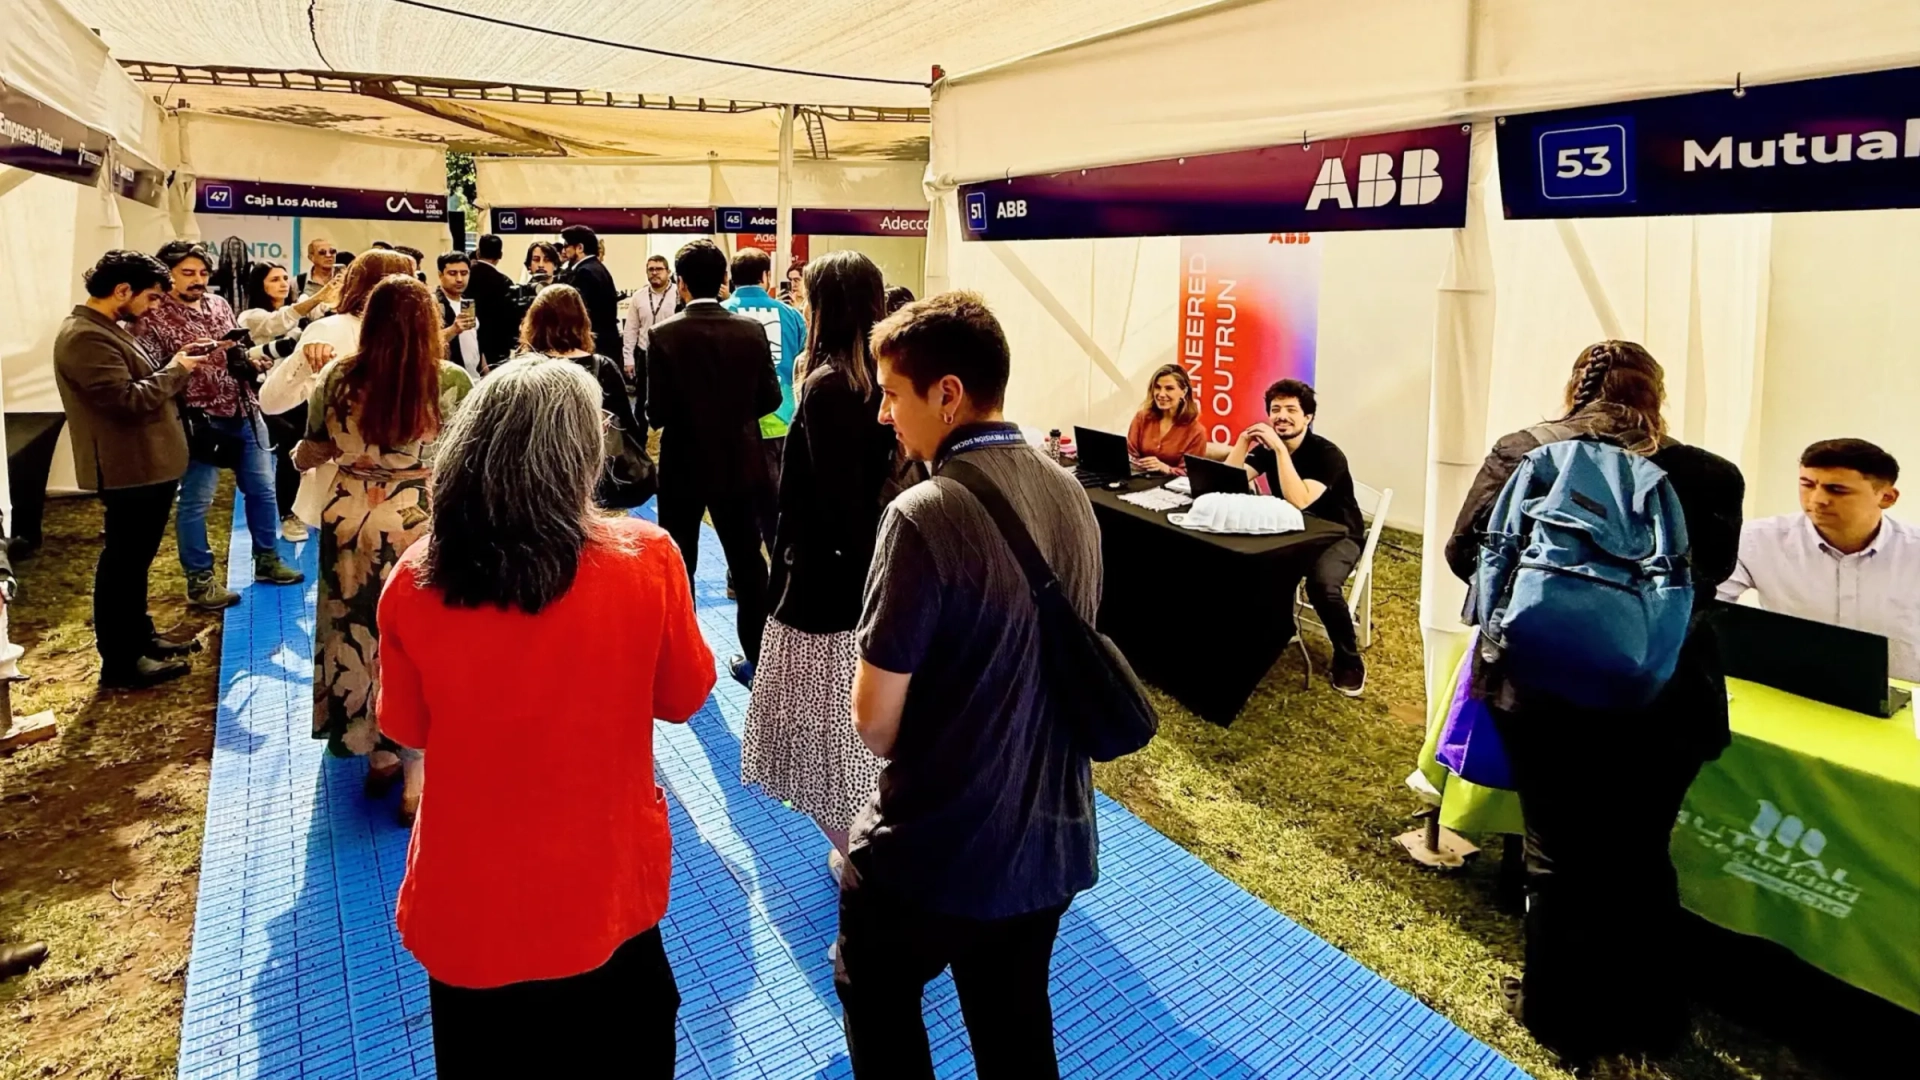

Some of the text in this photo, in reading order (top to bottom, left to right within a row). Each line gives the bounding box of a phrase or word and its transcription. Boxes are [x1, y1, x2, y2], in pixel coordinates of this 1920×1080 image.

[1683, 118, 1920, 172] Mutual
[1556, 145, 1612, 179] 53
[1305, 148, 1443, 210] ABB
[210, 191, 228, 202] 47
[244, 194, 338, 209] Caja Los Andes
[970, 203, 983, 219] 51
[997, 200, 1027, 218] ABB
[501, 217, 514, 225] 46
[525, 217, 563, 226] MetLife
[662, 216, 710, 228] MetLife
[727, 215, 740, 224] 45
[1212, 279, 1237, 416] OUTRUN
[951, 437, 974, 451] SOCIAL
